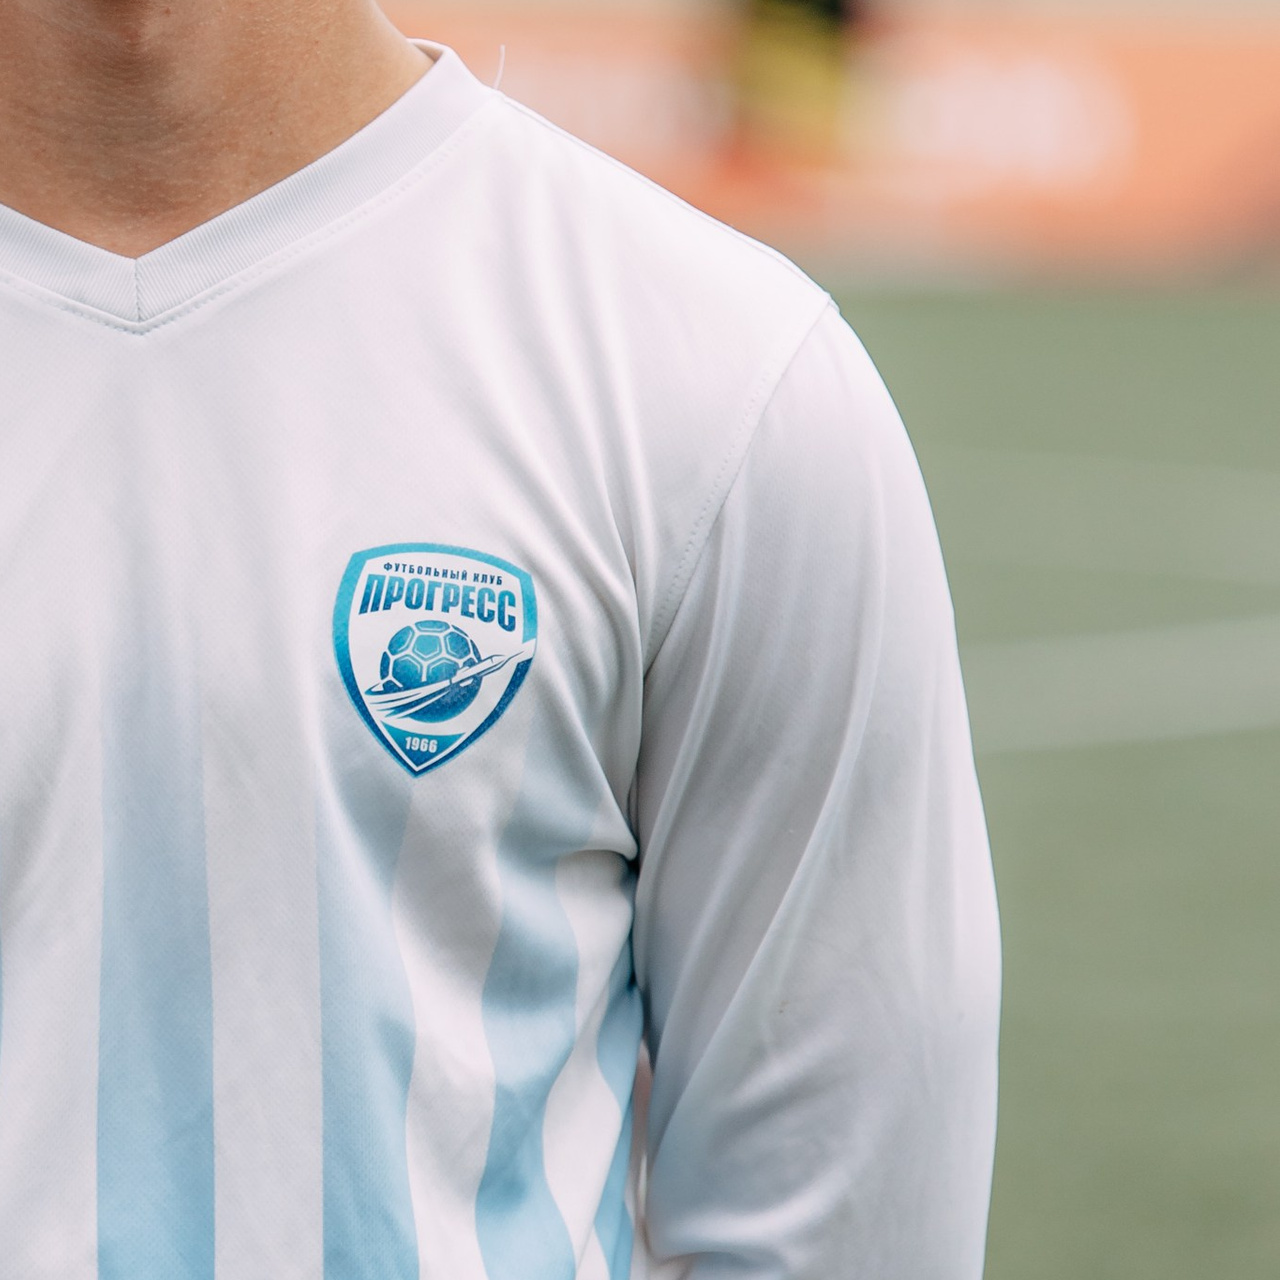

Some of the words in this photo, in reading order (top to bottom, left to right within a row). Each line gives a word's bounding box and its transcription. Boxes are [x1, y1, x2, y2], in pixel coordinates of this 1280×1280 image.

[383, 562, 467, 581] ФУТБОЛЬНЫЙ
[473, 573, 503, 586] КЛУБ
[358, 574, 516, 632] ПРОГРЕСС
[405, 736, 438, 753] 1966
